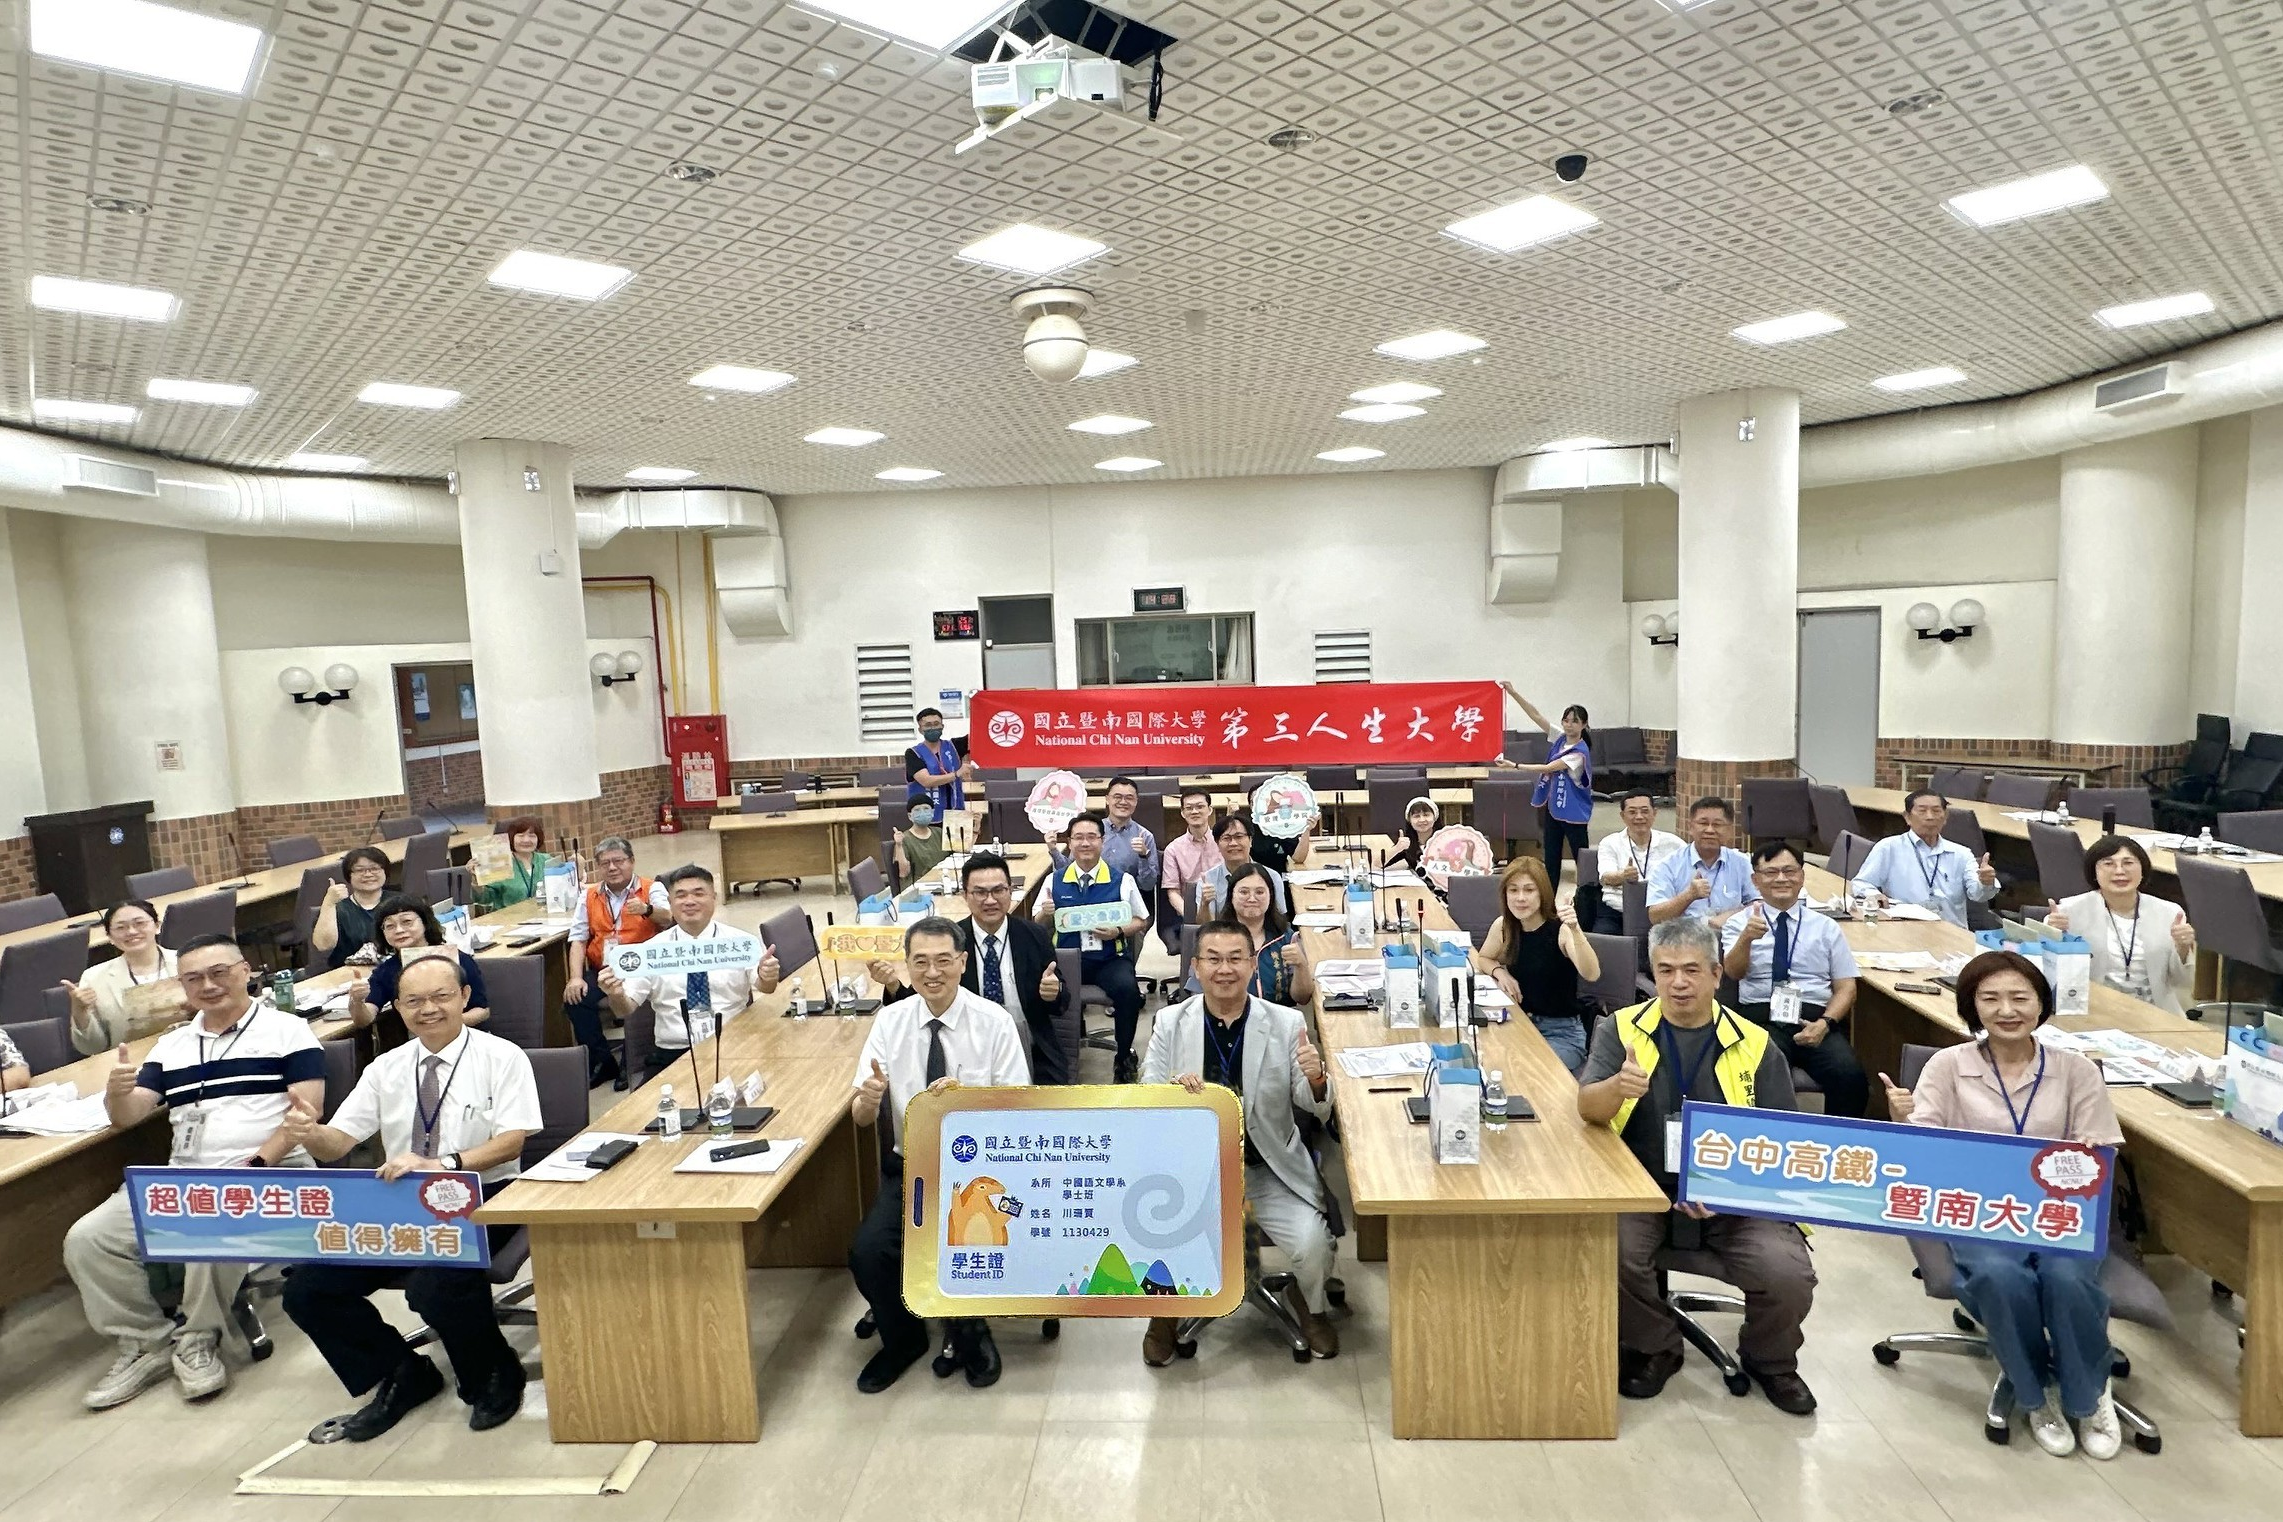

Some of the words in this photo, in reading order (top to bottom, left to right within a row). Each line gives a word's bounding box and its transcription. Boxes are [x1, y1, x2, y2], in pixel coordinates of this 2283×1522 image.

[1033, 711, 1208, 731] 國立暨南國際大學
[1219, 705, 1485, 750] 第三人生大學
[1035, 734, 1087, 746] National
[1089, 734, 1112, 746] Chi
[1114, 734, 1140, 746] Nan
[1143, 734, 1206, 748] University
[646, 941, 752, 960] 國立暨南國際大學
[837, 934, 856, 953] 我
[647, 961, 680, 970] National
[681, 958, 695, 967] Chi
[697, 957, 713, 966] Nan
[714, 954, 752, 963] University
[985, 1134, 1112, 1150] 國立暨南國際大學
[985, 1152, 1023, 1162] National
[1025, 1152, 1042, 1162] Chi
[1044, 1152, 1062, 1162] Nan
[1065, 1152, 1111, 1164] University
[2053, 1156, 2081, 1165] FREE
[2056, 1166, 2083, 1175] PASS
[435, 1183, 455, 1192] FREE
[1031, 1178, 1051, 1188] 系所
[1063, 1177, 1126, 1188] 中國語文學系
[147, 1185, 332, 1217] 超值學生證
[438, 1191, 459, 1201] PASS
[1063, 1189, 1094, 1201] 學士班
[1030, 1208, 1051, 1219] 姓名
[1885, 1185, 2081, 1239] 暨南大學
[317, 1223, 461, 1254] 值得擁有
[1030, 1227, 1051, 1238] 學號
[1062, 1227, 1110, 1237] 1130429
[952, 1252, 1004, 1269] 學生證
[951, 1270, 990, 1279] Student
[992, 1270, 1004, 1279] ID
